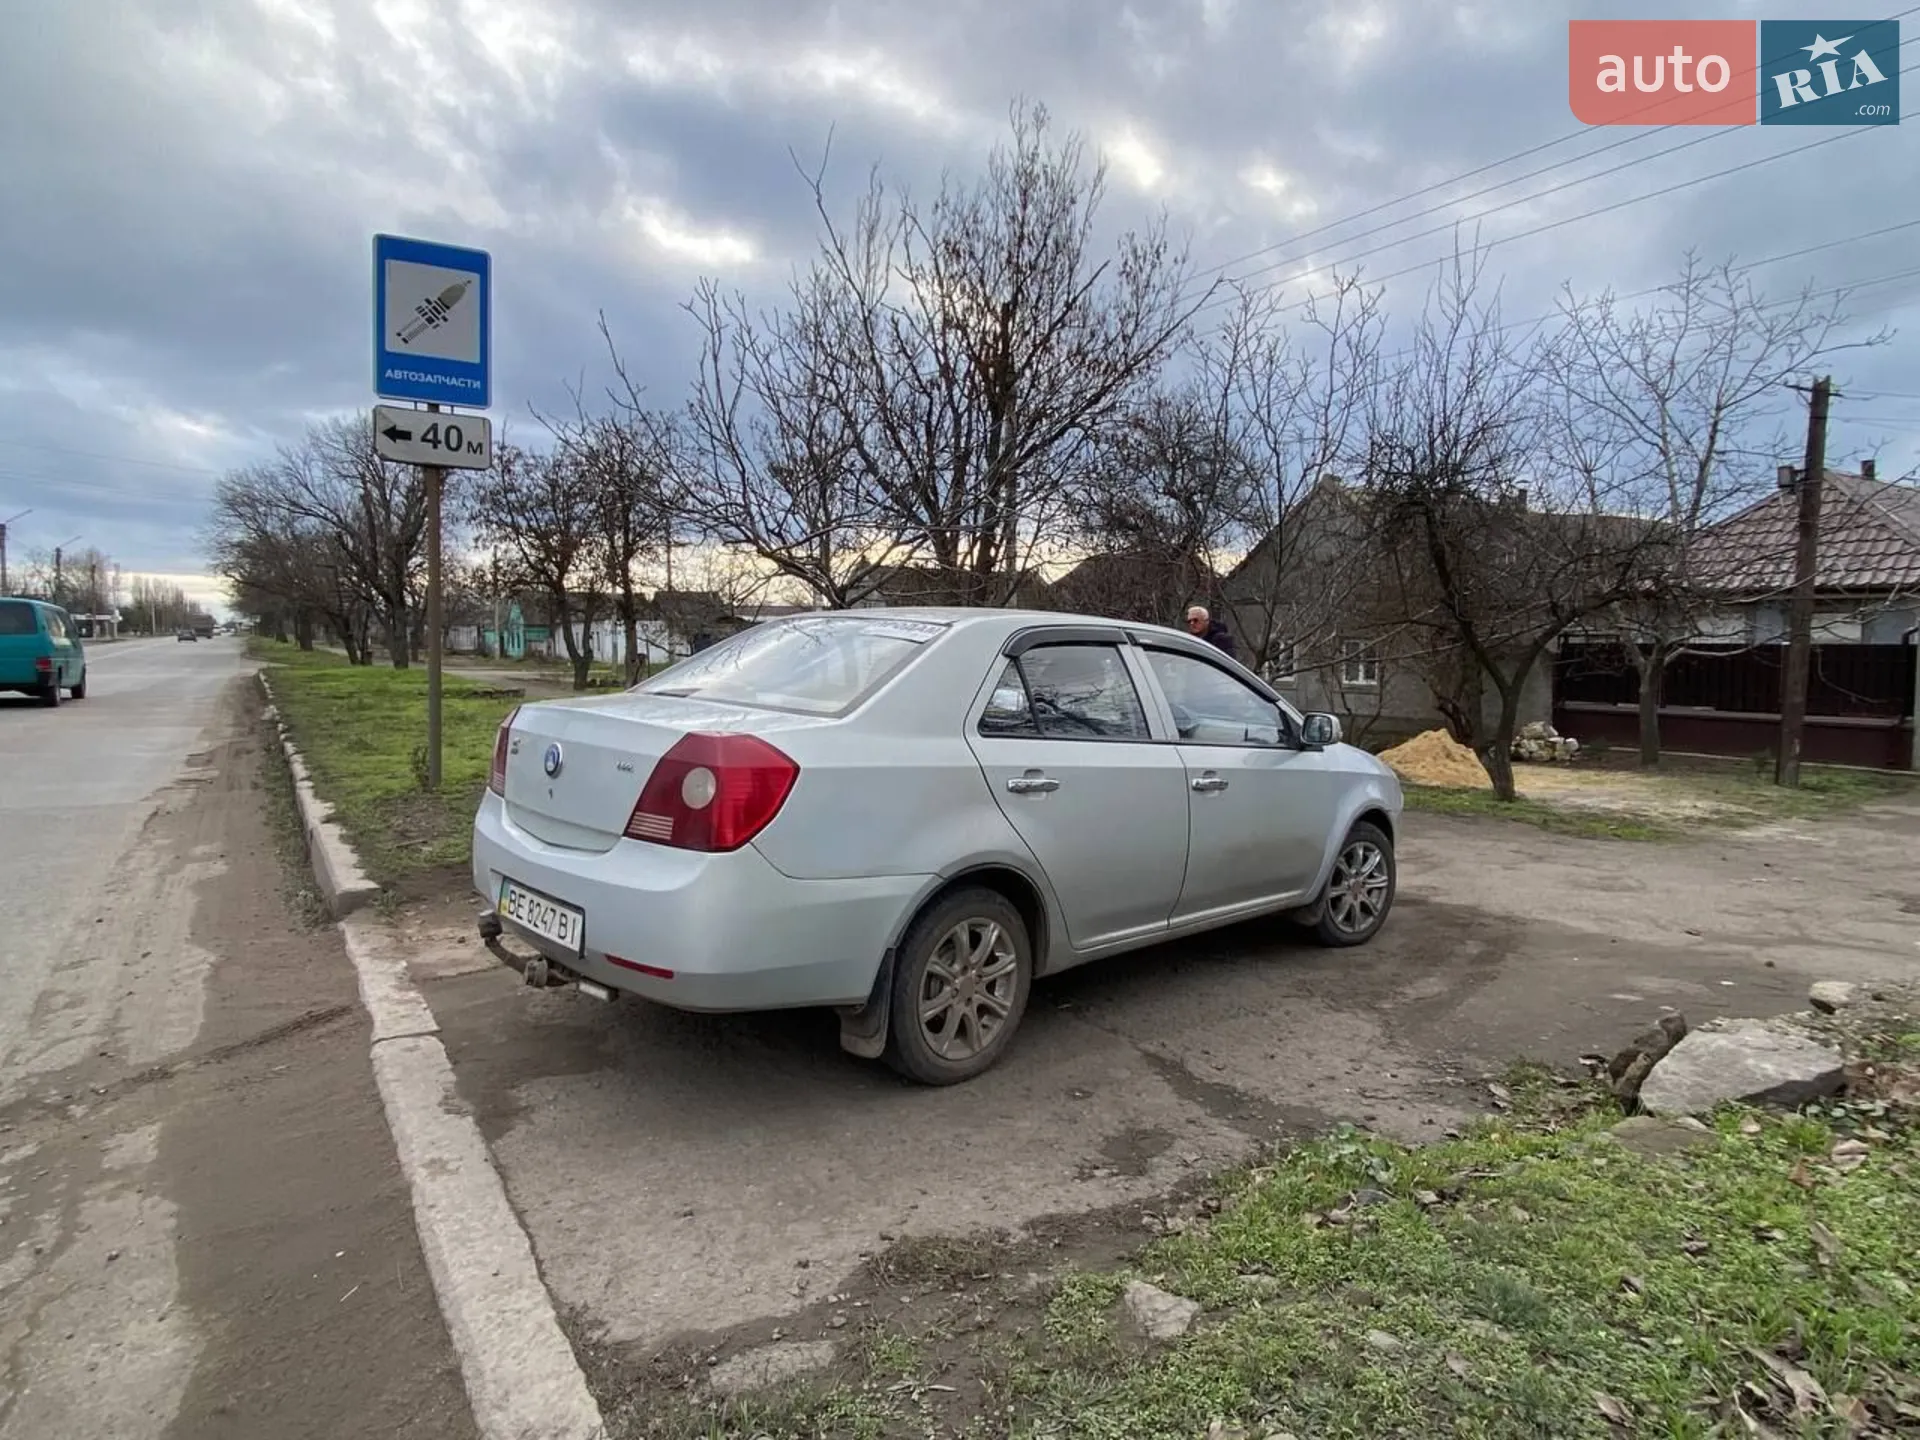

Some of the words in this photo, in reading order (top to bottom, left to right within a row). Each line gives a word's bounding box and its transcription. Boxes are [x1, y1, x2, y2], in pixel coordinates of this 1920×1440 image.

[385, 368, 481, 389] АВТОЗАПЧАСТИ
[420, 422, 464, 452] 40
[508, 889, 526, 921] BE
[527, 899, 557, 934] 8247
